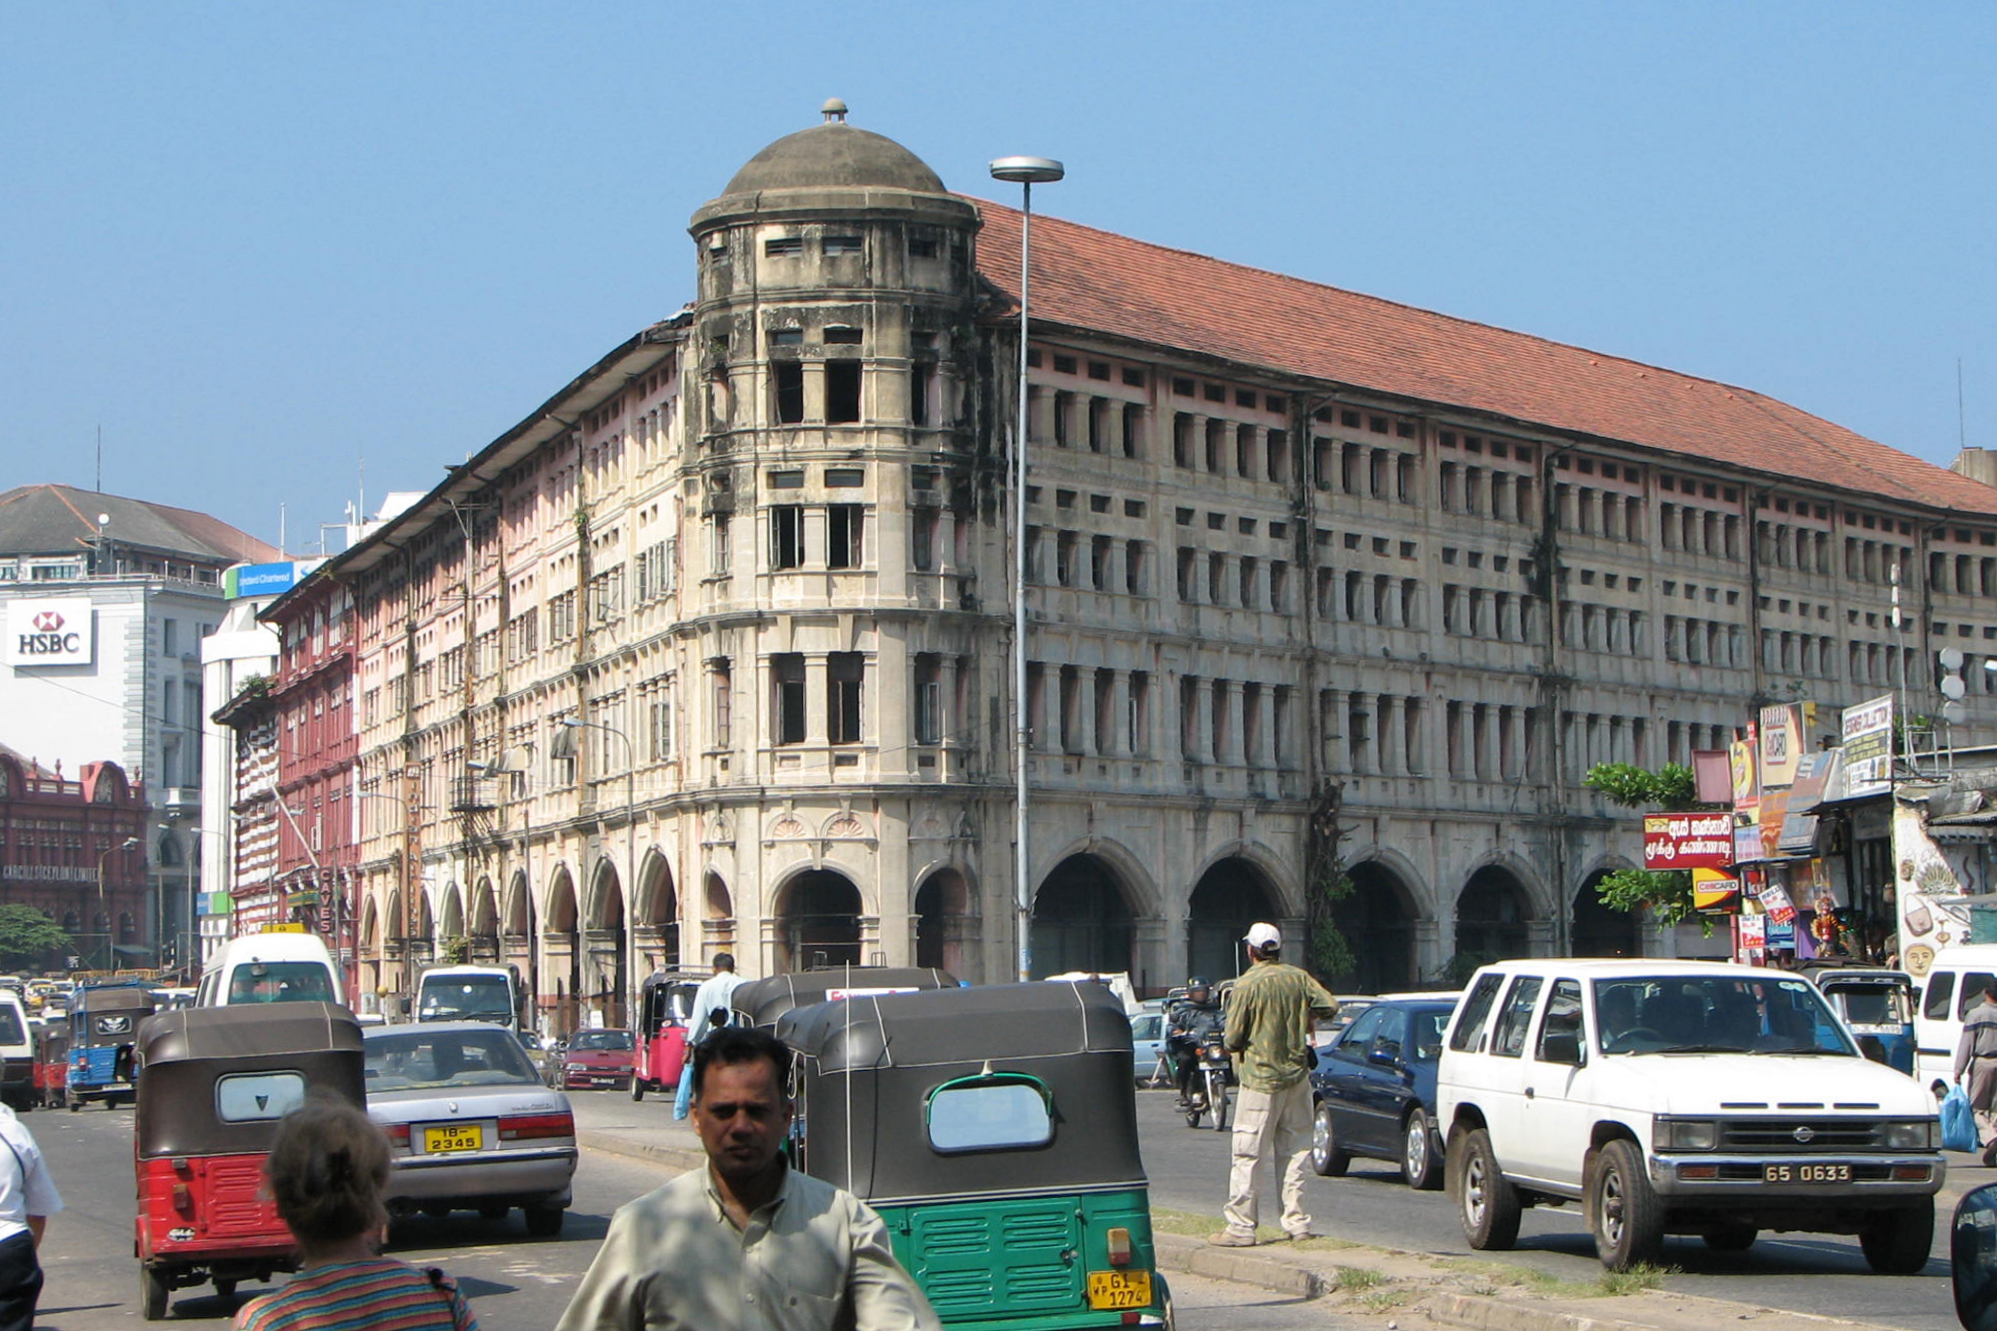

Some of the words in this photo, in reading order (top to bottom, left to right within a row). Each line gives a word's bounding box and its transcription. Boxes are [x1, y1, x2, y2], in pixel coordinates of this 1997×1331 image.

[18, 632, 80, 654] HSBC
[320, 869, 331, 932] CAVES
[431, 1138, 476, 1150] 2345
[1766, 1166, 1790, 1182] 65
[1800, 1165, 1849, 1181] 0633
[1093, 1286, 1108, 1296] WP
[1109, 1290, 1142, 1306] 1274
